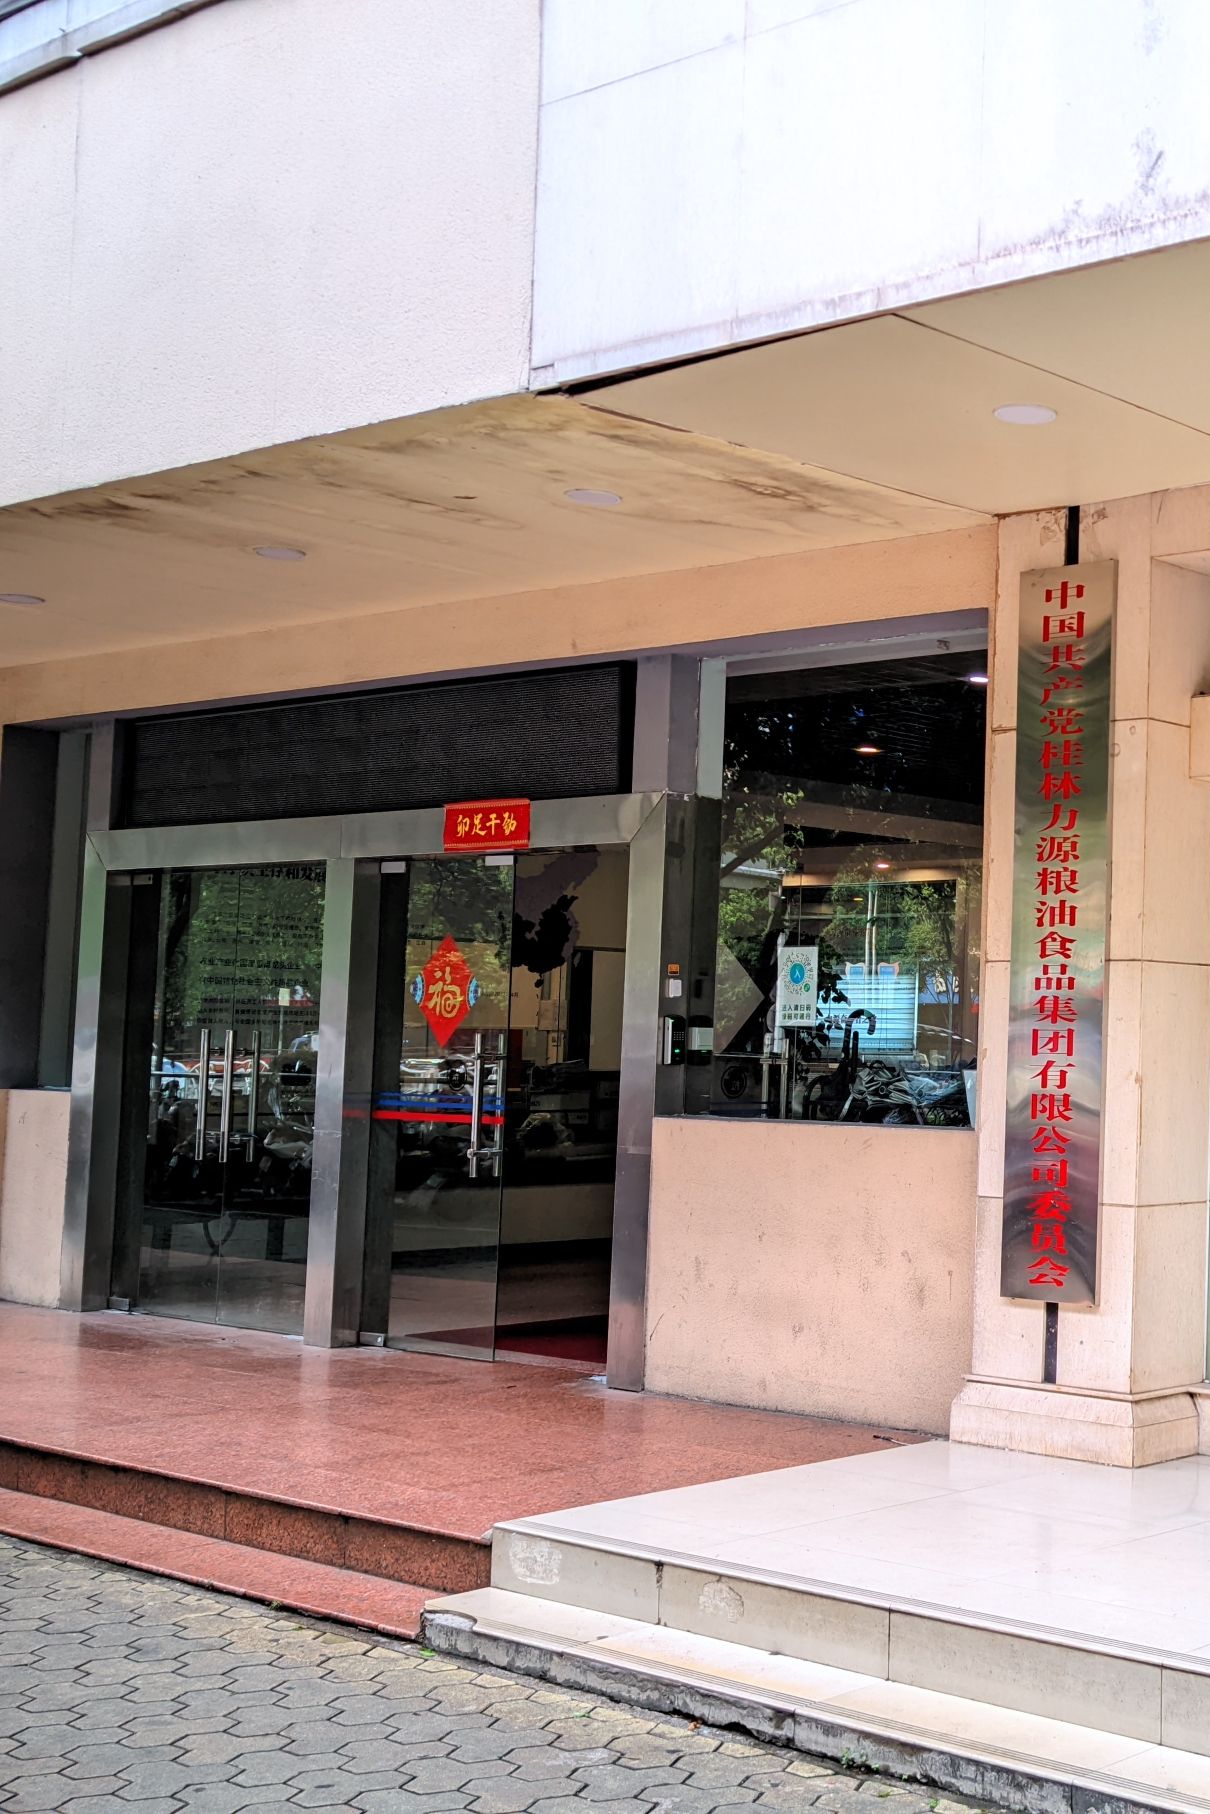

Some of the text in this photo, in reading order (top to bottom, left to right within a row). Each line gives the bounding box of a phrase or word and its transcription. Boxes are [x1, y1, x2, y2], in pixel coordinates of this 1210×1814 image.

[455, 811, 518, 838] 卯足干劲
[1026, 580, 1087, 1288] 中国共产党桂林力源粮油食品集团有限公司委员会
[427, 966, 465, 1018] 福
